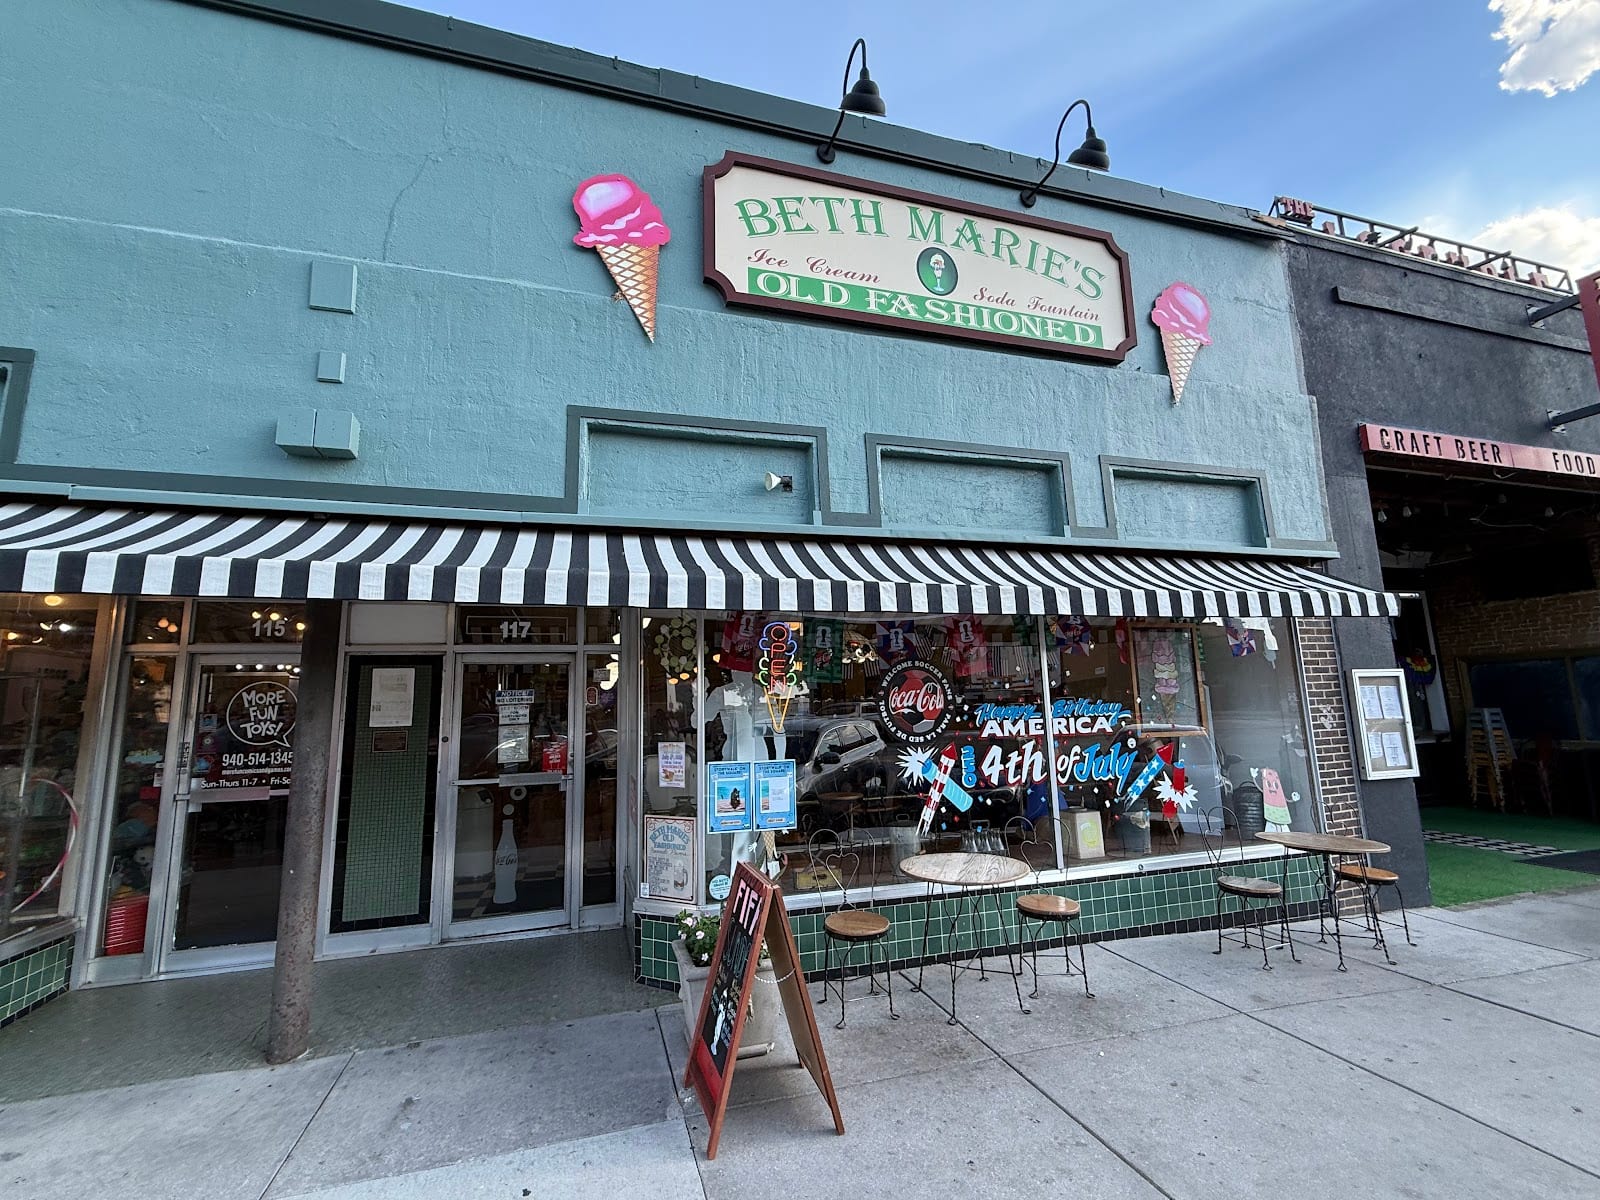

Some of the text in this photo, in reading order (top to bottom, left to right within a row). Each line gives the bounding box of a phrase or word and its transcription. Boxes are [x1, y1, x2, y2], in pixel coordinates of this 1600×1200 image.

[1281, 197, 1315, 218] THE
[735, 196, 1106, 301] BETH MARIE'S
[747, 248, 881, 284] Ice Cream
[756, 272, 1097, 345] OLD FASHIONED
[973, 286, 1101, 322] Soda Fountain
[1379, 428, 1503, 464] CRAFT BEER
[1552, 451, 1596, 475] FOOD
[252, 619, 286, 637] 115
[500, 621, 531, 639] 117
[771, 625, 788, 694] OPEN
[881, 660, 953, 700] WELCOME SOCCER FANS
[241, 689, 286, 708] MORE
[249, 704, 279, 722] FUN
[888, 682, 945, 715] Coca-Cola
[974, 697, 1132, 728] Happy Birthday
[239, 721, 284, 739] TOYS!
[879, 699, 952, 743] PARA LA SED DE FUTBOL
[979, 716, 1113, 738] AMERICA
[221, 751, 294, 767] 940-514-1345
[980, 739, 1048, 786] 4th
[1056, 744, 1081, 784] of
[1073, 741, 1138, 796] July
[201, 779, 239, 789] Sun-Thurs
[242, 778, 258, 786] 11-7
